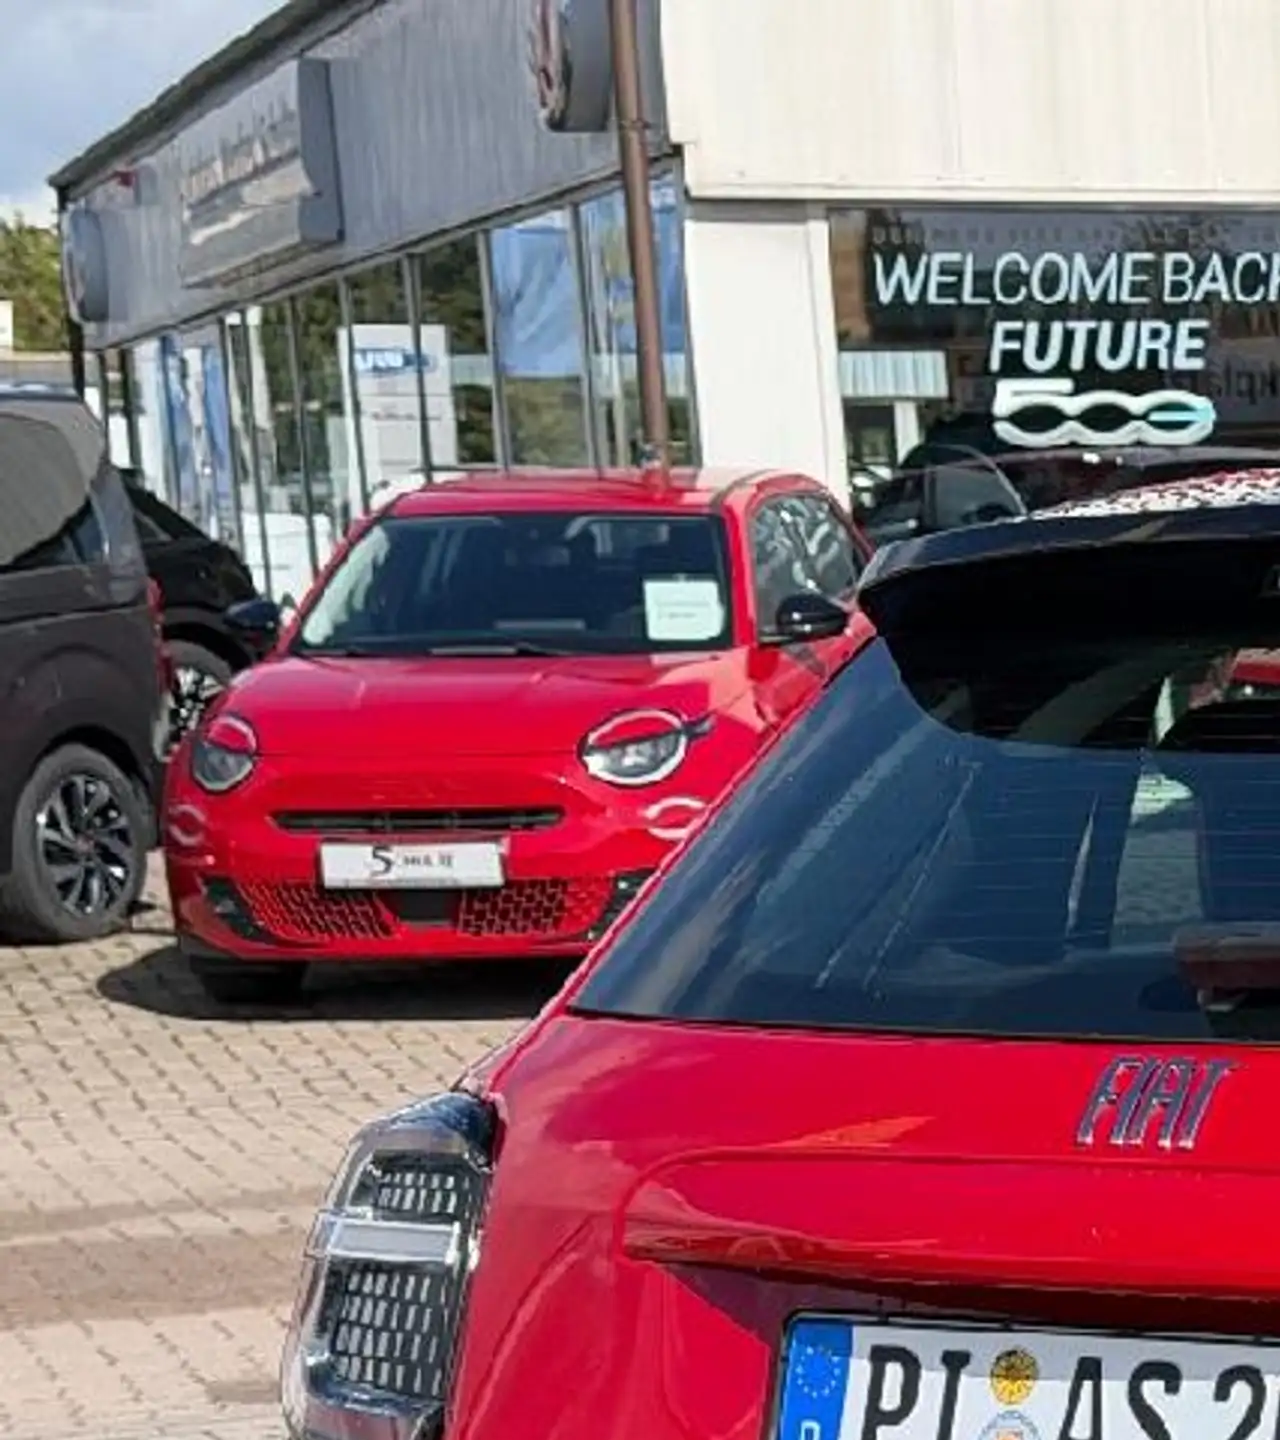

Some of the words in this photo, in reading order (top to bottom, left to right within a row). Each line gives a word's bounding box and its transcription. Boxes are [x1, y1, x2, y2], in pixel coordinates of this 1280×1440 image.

[874, 251, 1156, 304] WELCOME
[990, 319, 1211, 372] FUTURE
[1076, 1054, 1244, 1151] FIAT
